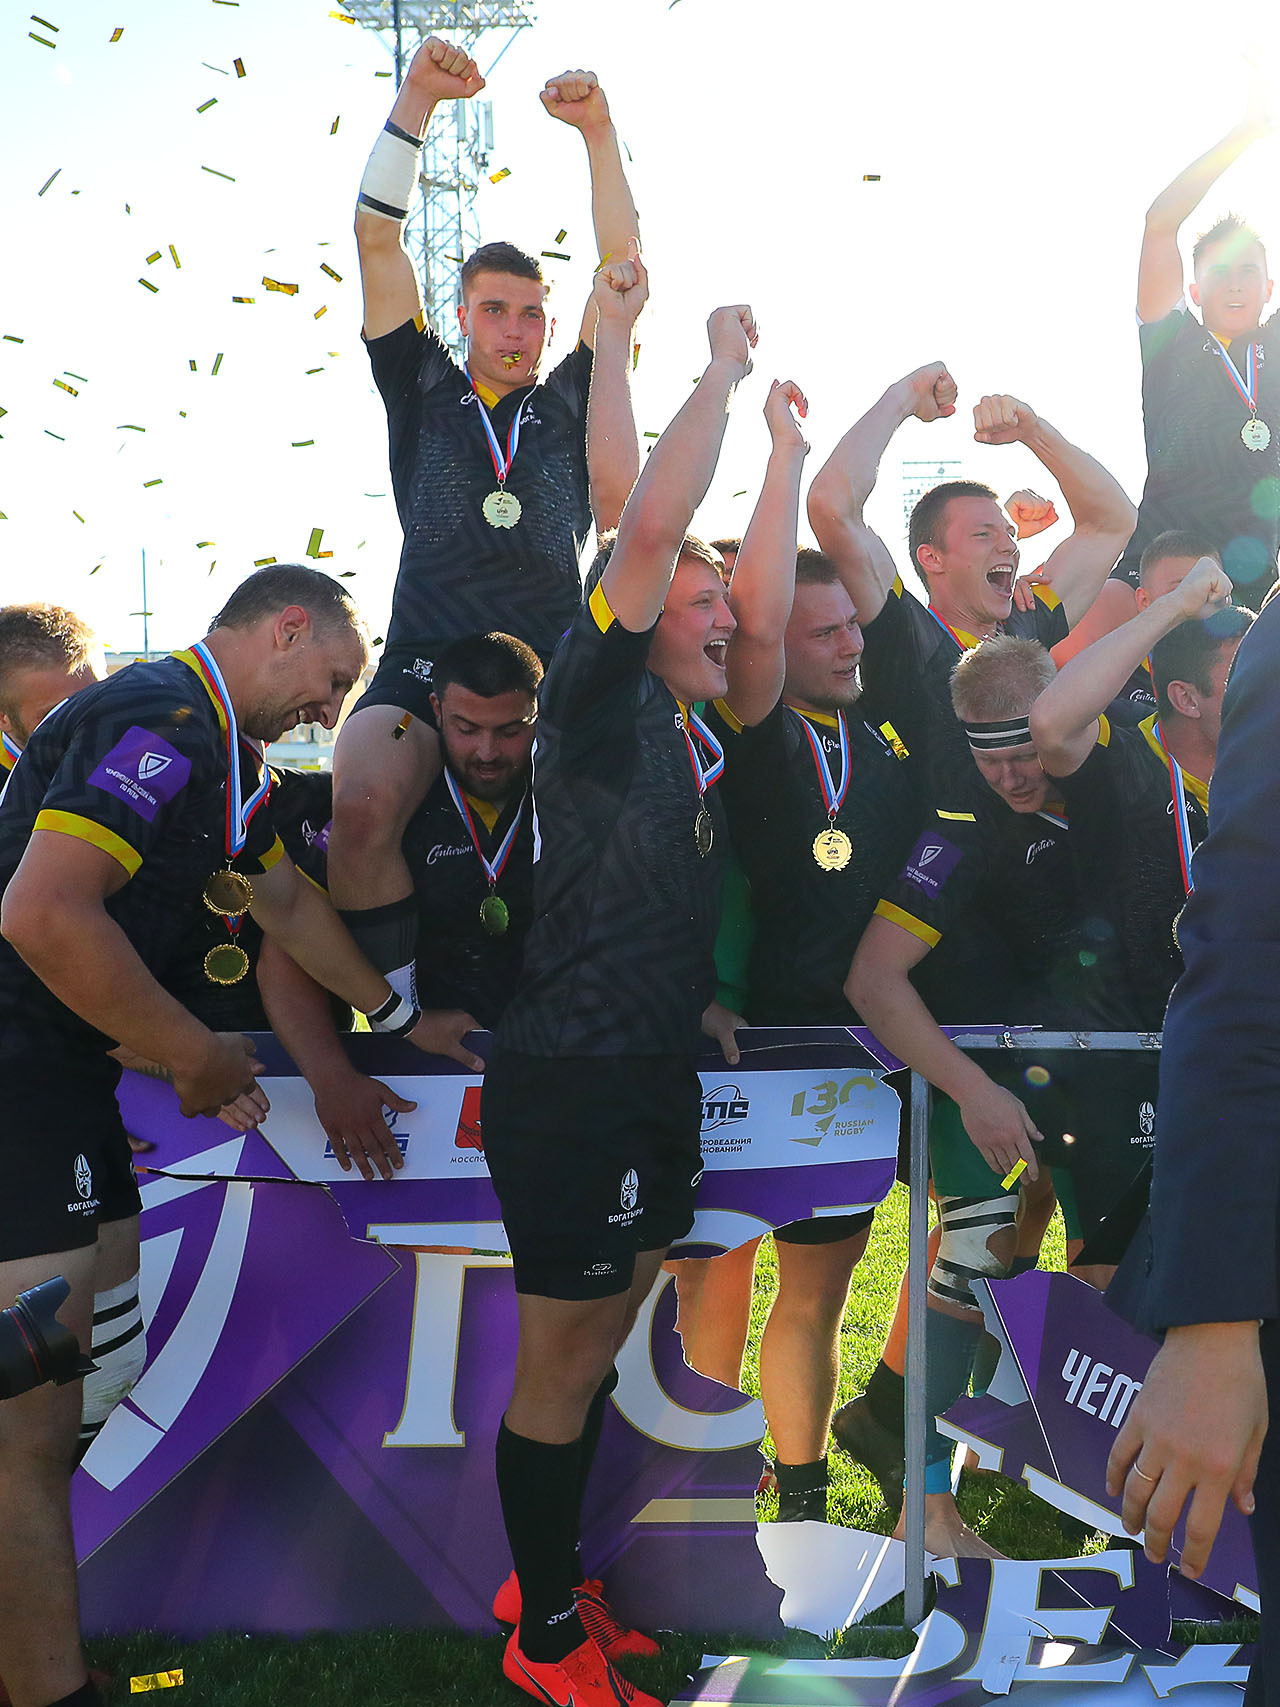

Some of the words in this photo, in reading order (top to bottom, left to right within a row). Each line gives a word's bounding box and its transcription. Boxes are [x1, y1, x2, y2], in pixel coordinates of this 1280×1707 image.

[427, 844, 473, 865] Centurion
[700, 1101, 749, 1119] ПС
[835, 1119, 874, 1129] RUSSIAN
[834, 1127, 865, 1136] RUGBY
[450, 1156, 486, 1164] МОССПО
[1062, 1348, 1144, 1429] ЧЕМ
